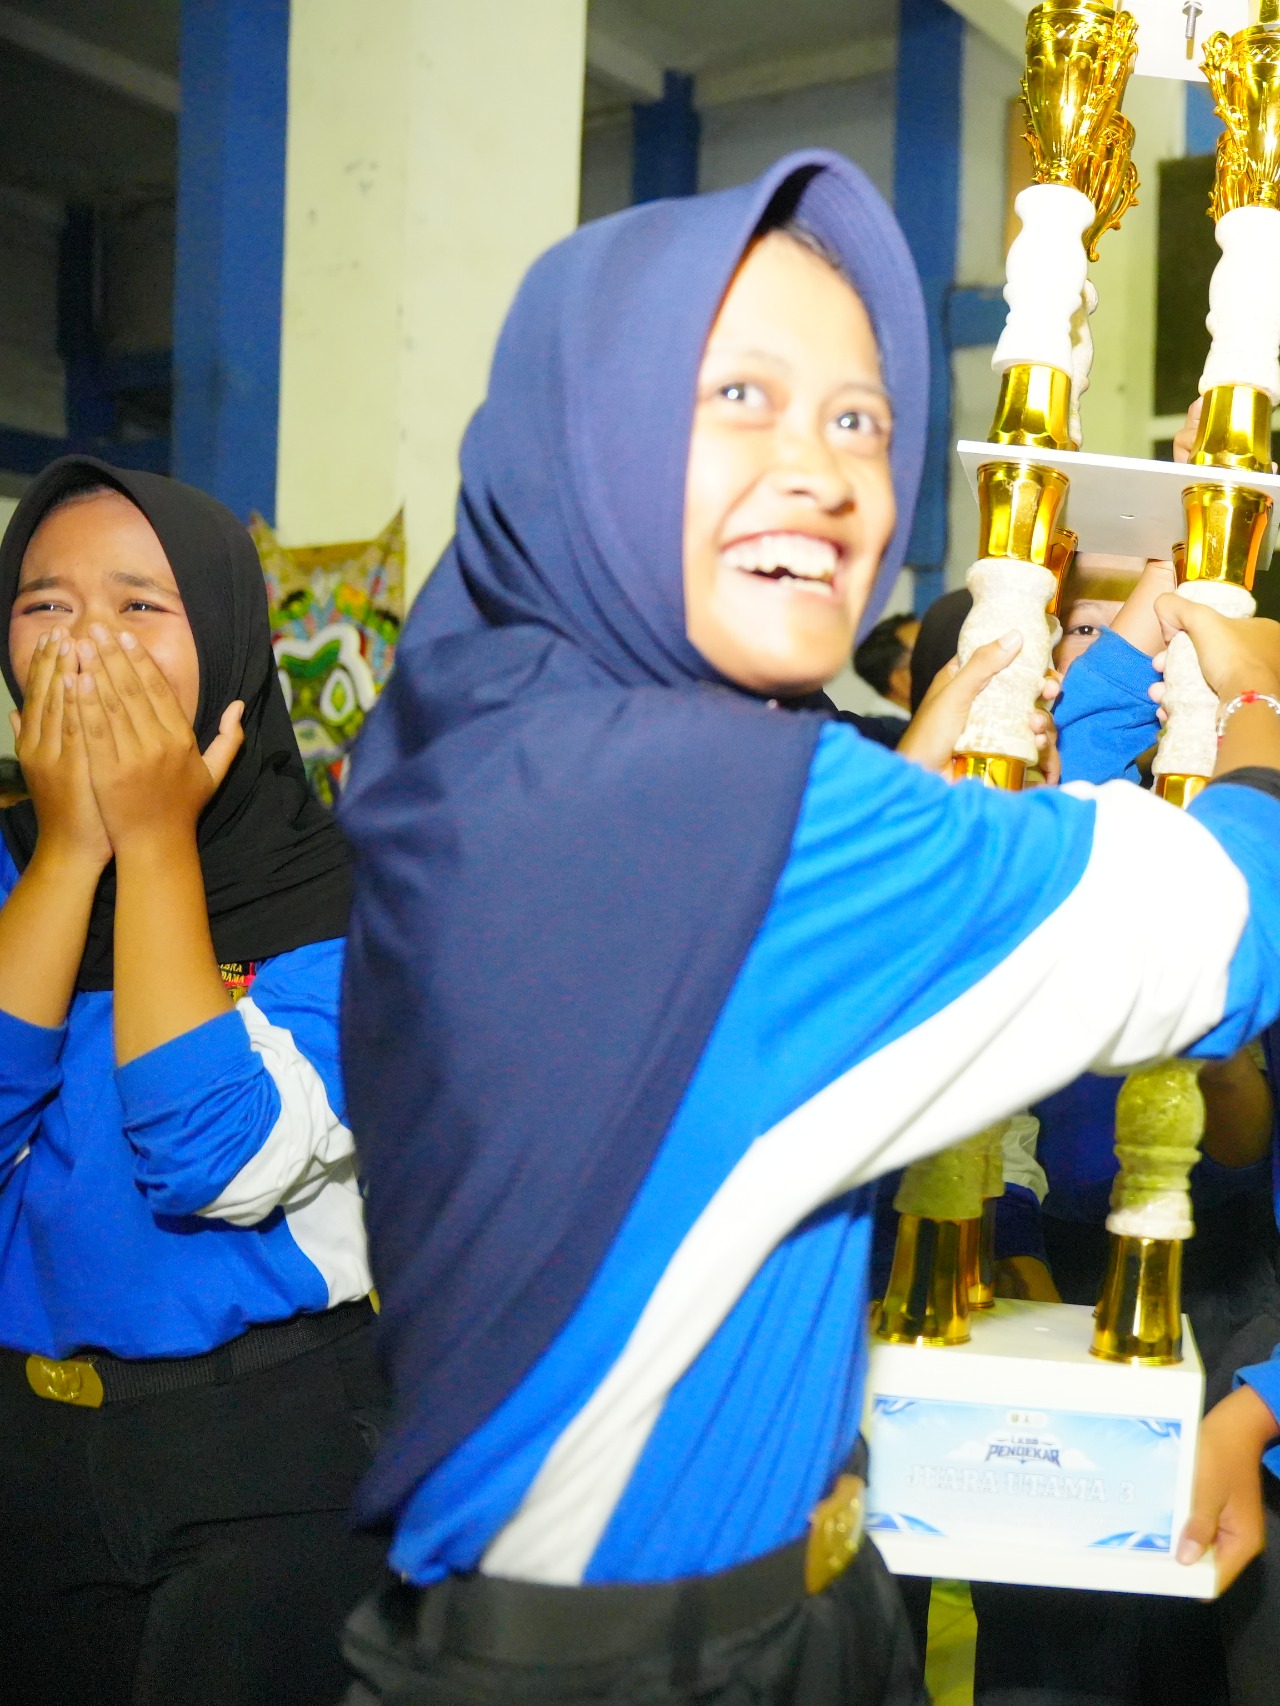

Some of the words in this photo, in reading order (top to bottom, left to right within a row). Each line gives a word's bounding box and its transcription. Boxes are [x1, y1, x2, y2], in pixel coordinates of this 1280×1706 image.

[984, 1444, 1062, 1468] PENDEKAR
[905, 1463, 998, 1494] JUARA
[1005, 1471, 1106, 1502] UTAMA
